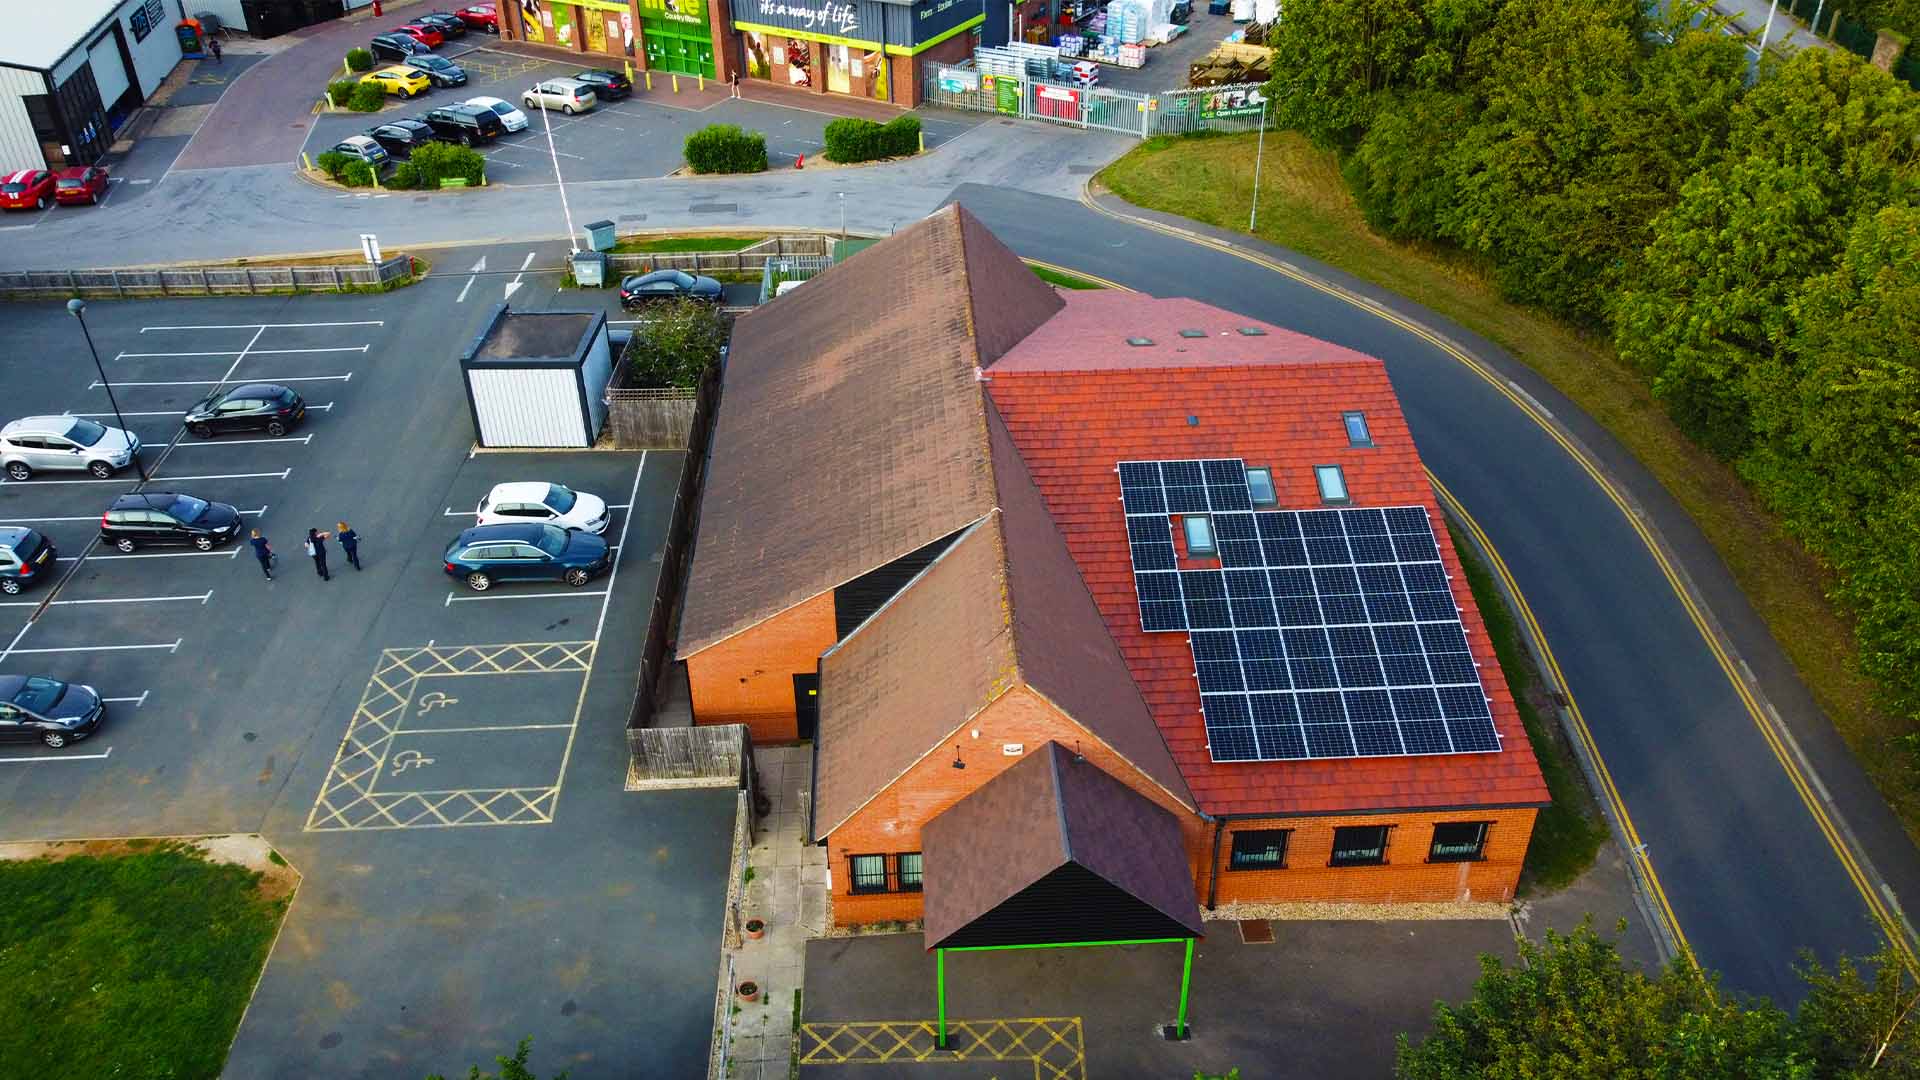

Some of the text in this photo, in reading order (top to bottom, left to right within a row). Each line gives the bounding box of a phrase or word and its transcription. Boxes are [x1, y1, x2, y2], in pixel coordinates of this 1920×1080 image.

[776, 4, 786, 15] a
[788, 6, 815, 28] way
[817, 1, 832, 27] of
[832, 4, 857, 33] life
[1216, 109, 1231, 117] Open
